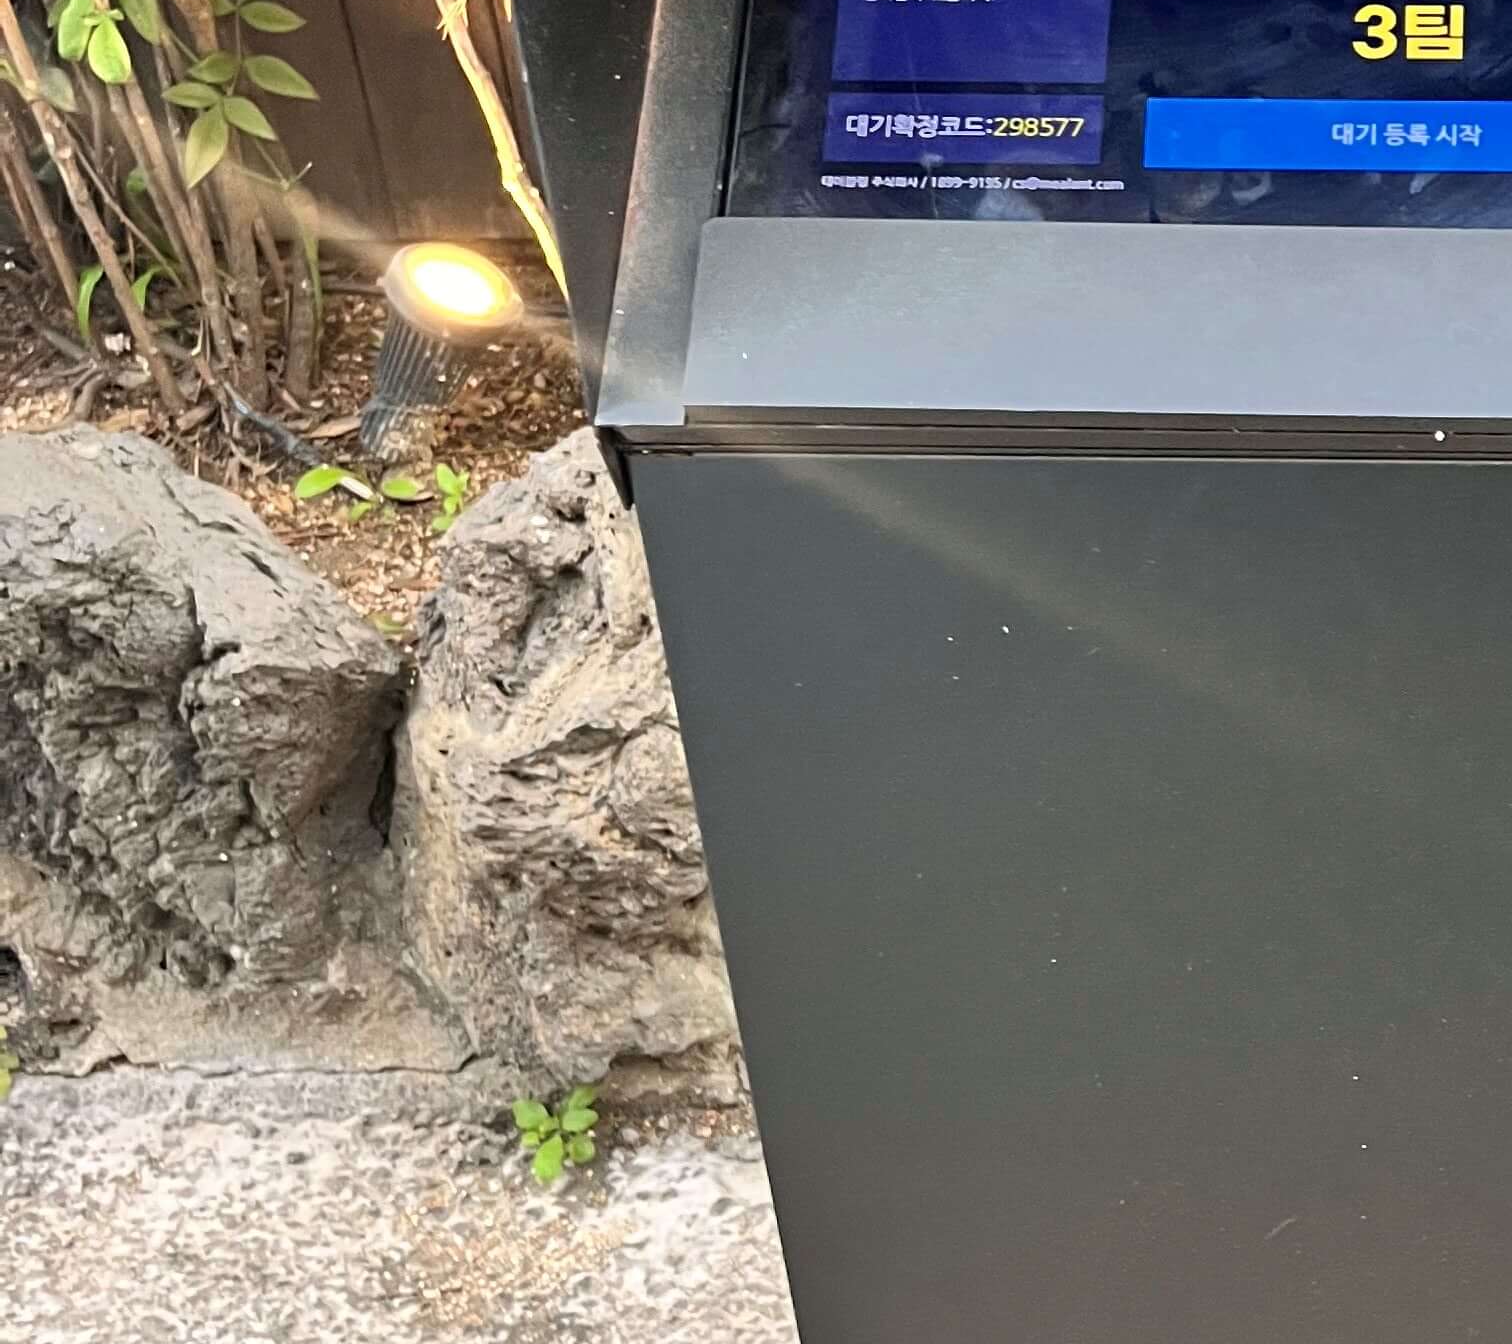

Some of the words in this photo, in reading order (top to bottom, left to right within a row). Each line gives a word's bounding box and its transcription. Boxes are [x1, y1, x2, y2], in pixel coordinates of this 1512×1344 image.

[1352, 3, 1466, 62] 3팀
[845, 113, 1086, 139] 대기확정코드:298577
[1330, 122, 1378, 148] 대기
[1382, 122, 1430, 148] 등록
[1435, 122, 1484, 149] 시작
[919, 175, 928, 189] /
[1003, 177, 1011, 190] /
